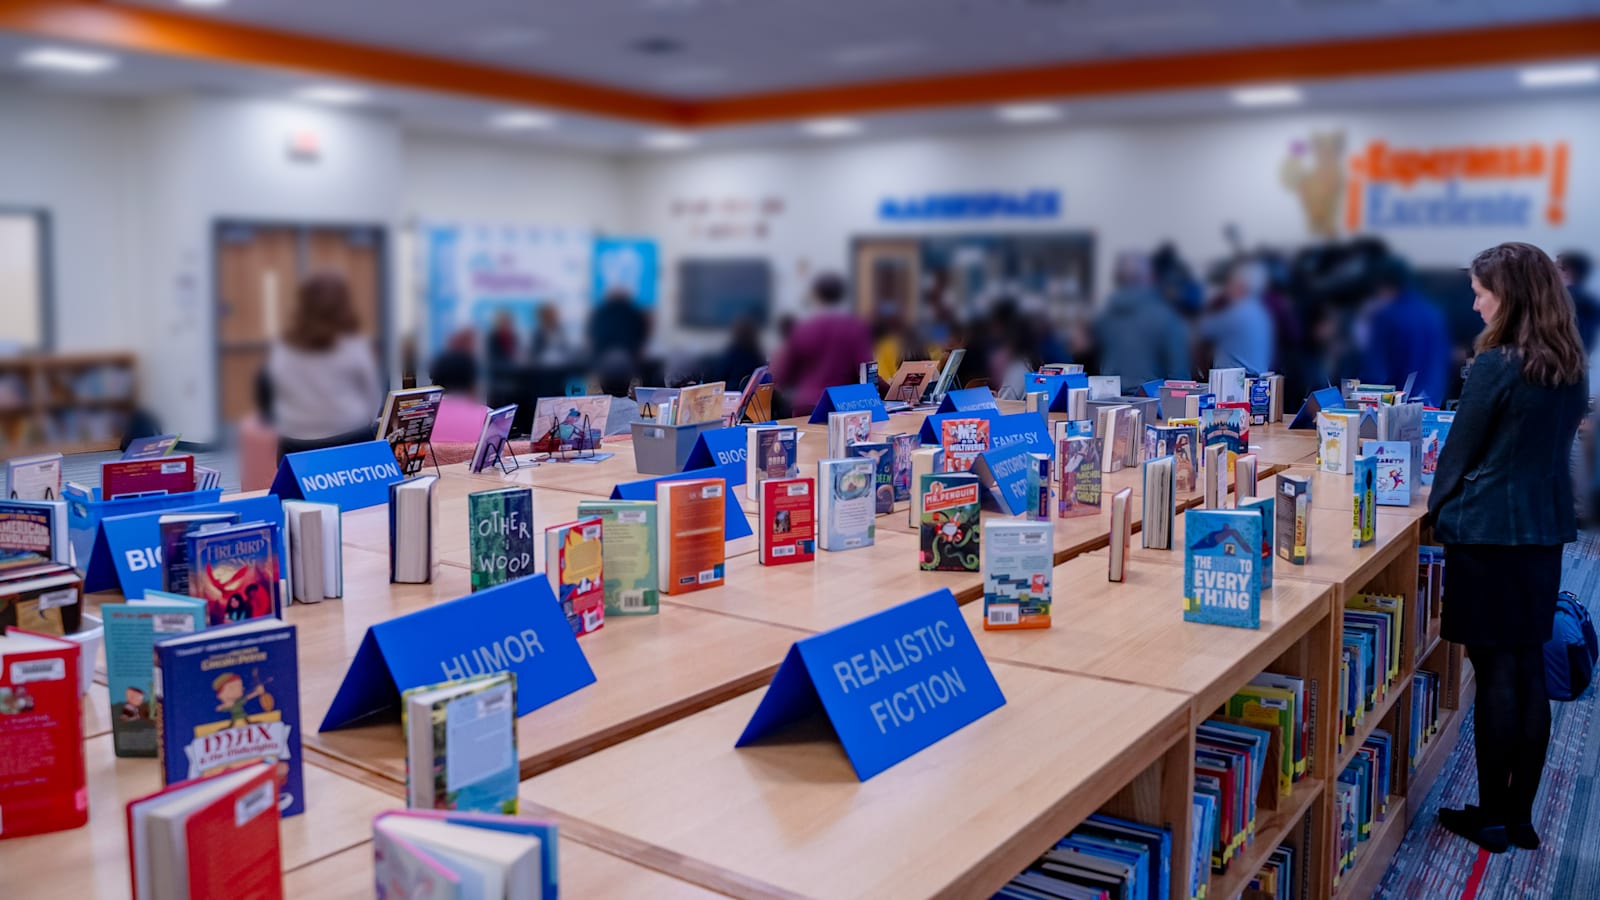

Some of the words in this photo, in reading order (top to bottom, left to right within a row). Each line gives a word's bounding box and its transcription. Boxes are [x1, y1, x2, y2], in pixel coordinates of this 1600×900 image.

[301, 461, 399, 493] NONFICTION
[940, 487, 975, 502] PENGUIN
[0, 520, 50, 537] MERICAN
[478, 510, 531, 539] OTHER
[0, 532, 51, 546] EVOLUTION
[478, 552, 530, 574] WOOD
[1193, 555, 1212, 570] THE
[1239, 559, 1253, 573] TO
[1194, 569, 1251, 592] EVERY
[440, 628, 545, 682] HUMOR
[832, 619, 955, 694] REALISTIC
[870, 666, 967, 735] FICTION
